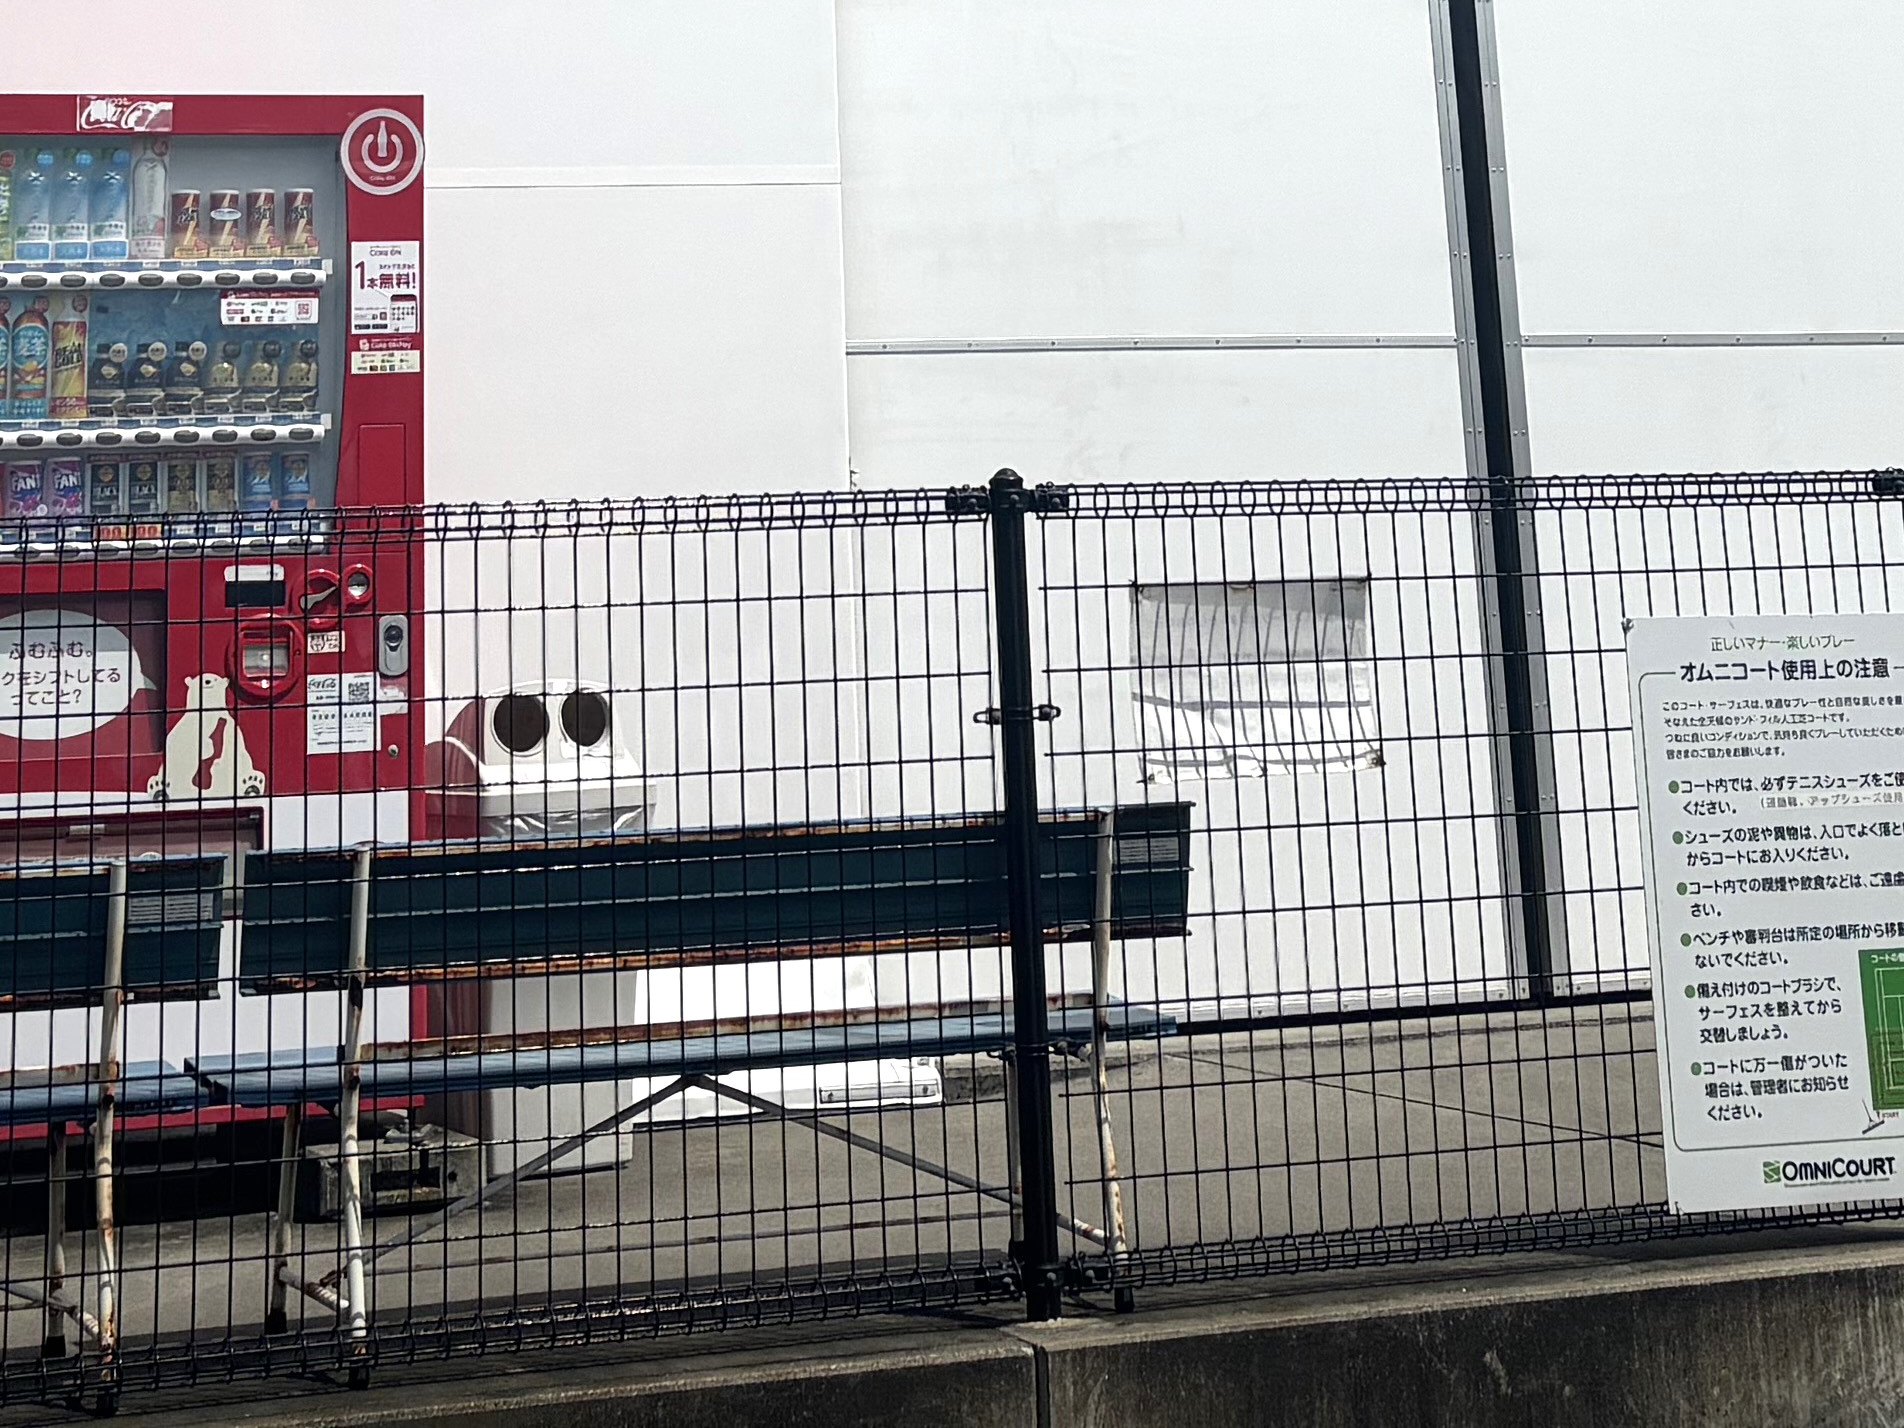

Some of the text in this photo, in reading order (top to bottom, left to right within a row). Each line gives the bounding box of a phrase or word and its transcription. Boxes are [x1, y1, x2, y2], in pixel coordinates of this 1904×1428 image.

[1680, 657, 1891, 682] オムニコート使用上の注意
[1682, 800, 1737, 816] ください。
[1687, 847, 1849, 866] からコートにお入りください。
[1690, 903, 1722, 918] さい。
[1695, 951, 1789, 968] ないでください。
[1699, 999, 1842, 1020] サーフェスを整えてから
[1705, 1076, 1849, 1099] 場合は、管理者にお知らせ
[1707, 1104, 1763, 1121] ください。
[1782, 1156, 1896, 1181] OMNICOURT
